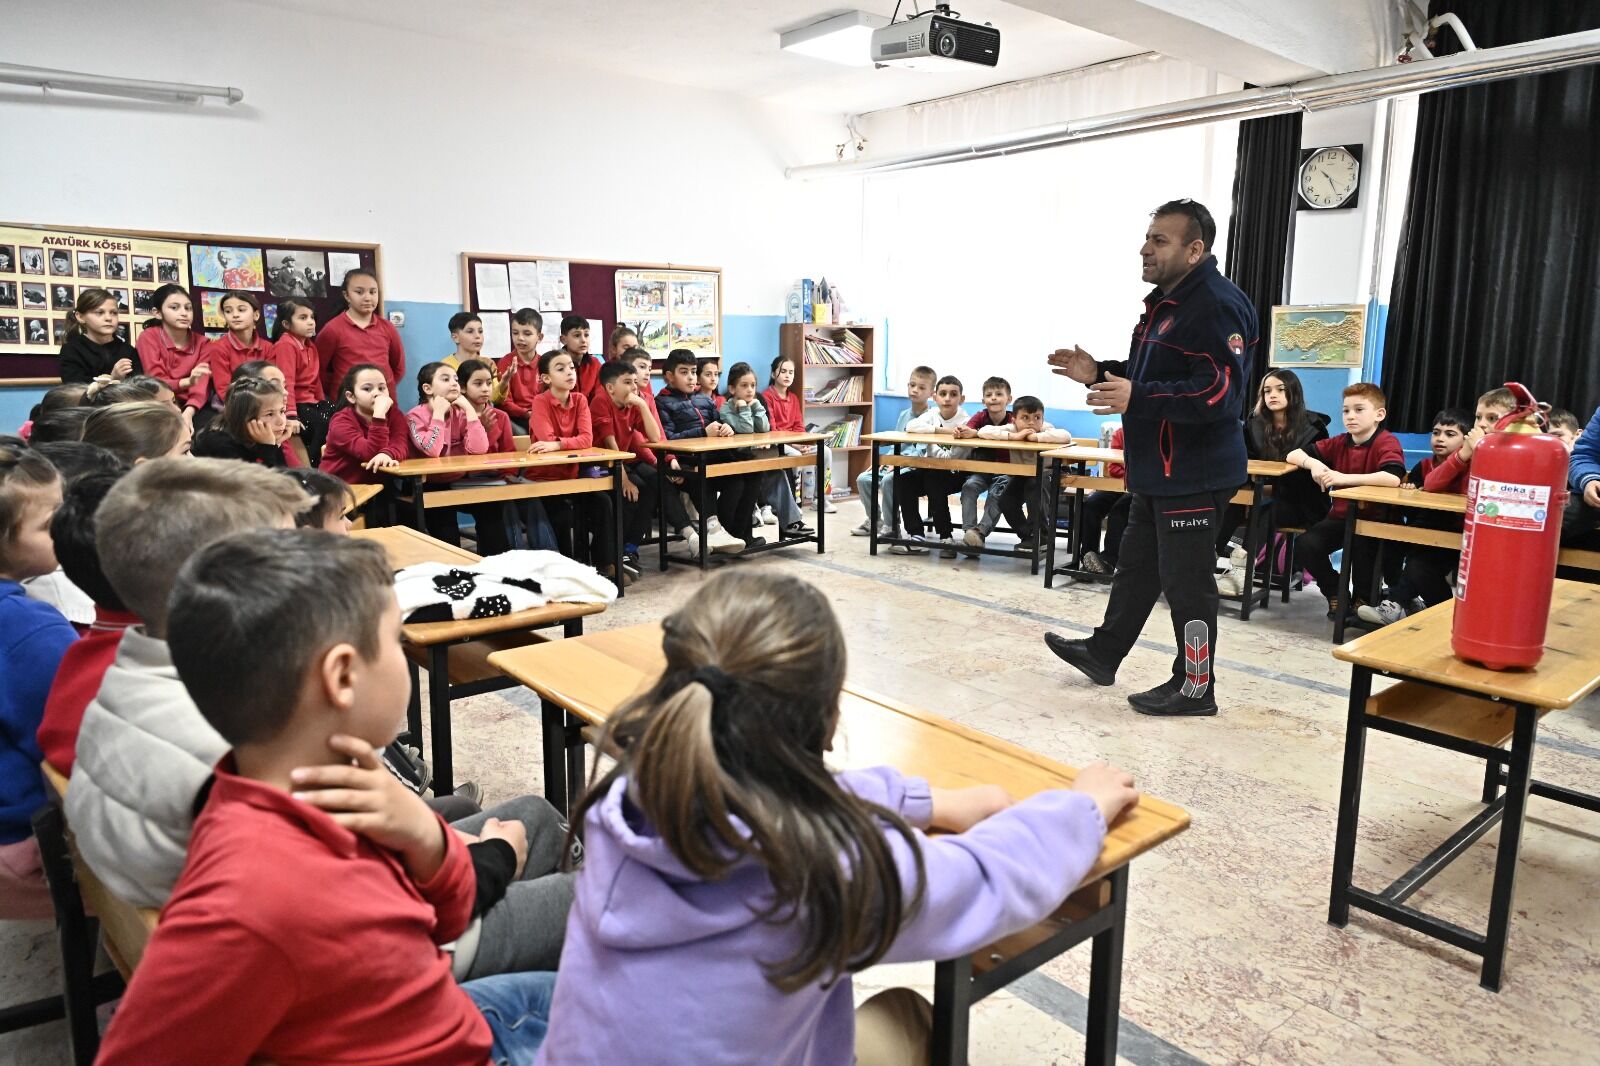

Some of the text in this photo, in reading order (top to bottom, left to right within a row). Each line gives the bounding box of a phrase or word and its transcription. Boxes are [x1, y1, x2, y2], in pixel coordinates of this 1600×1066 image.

[1327, 151, 1337, 160] 12
[1348, 162, 1354, 170] 2
[42, 236, 131, 251] ATATÜRK KÖŞESİ
[1500, 485, 1526, 494] deka
